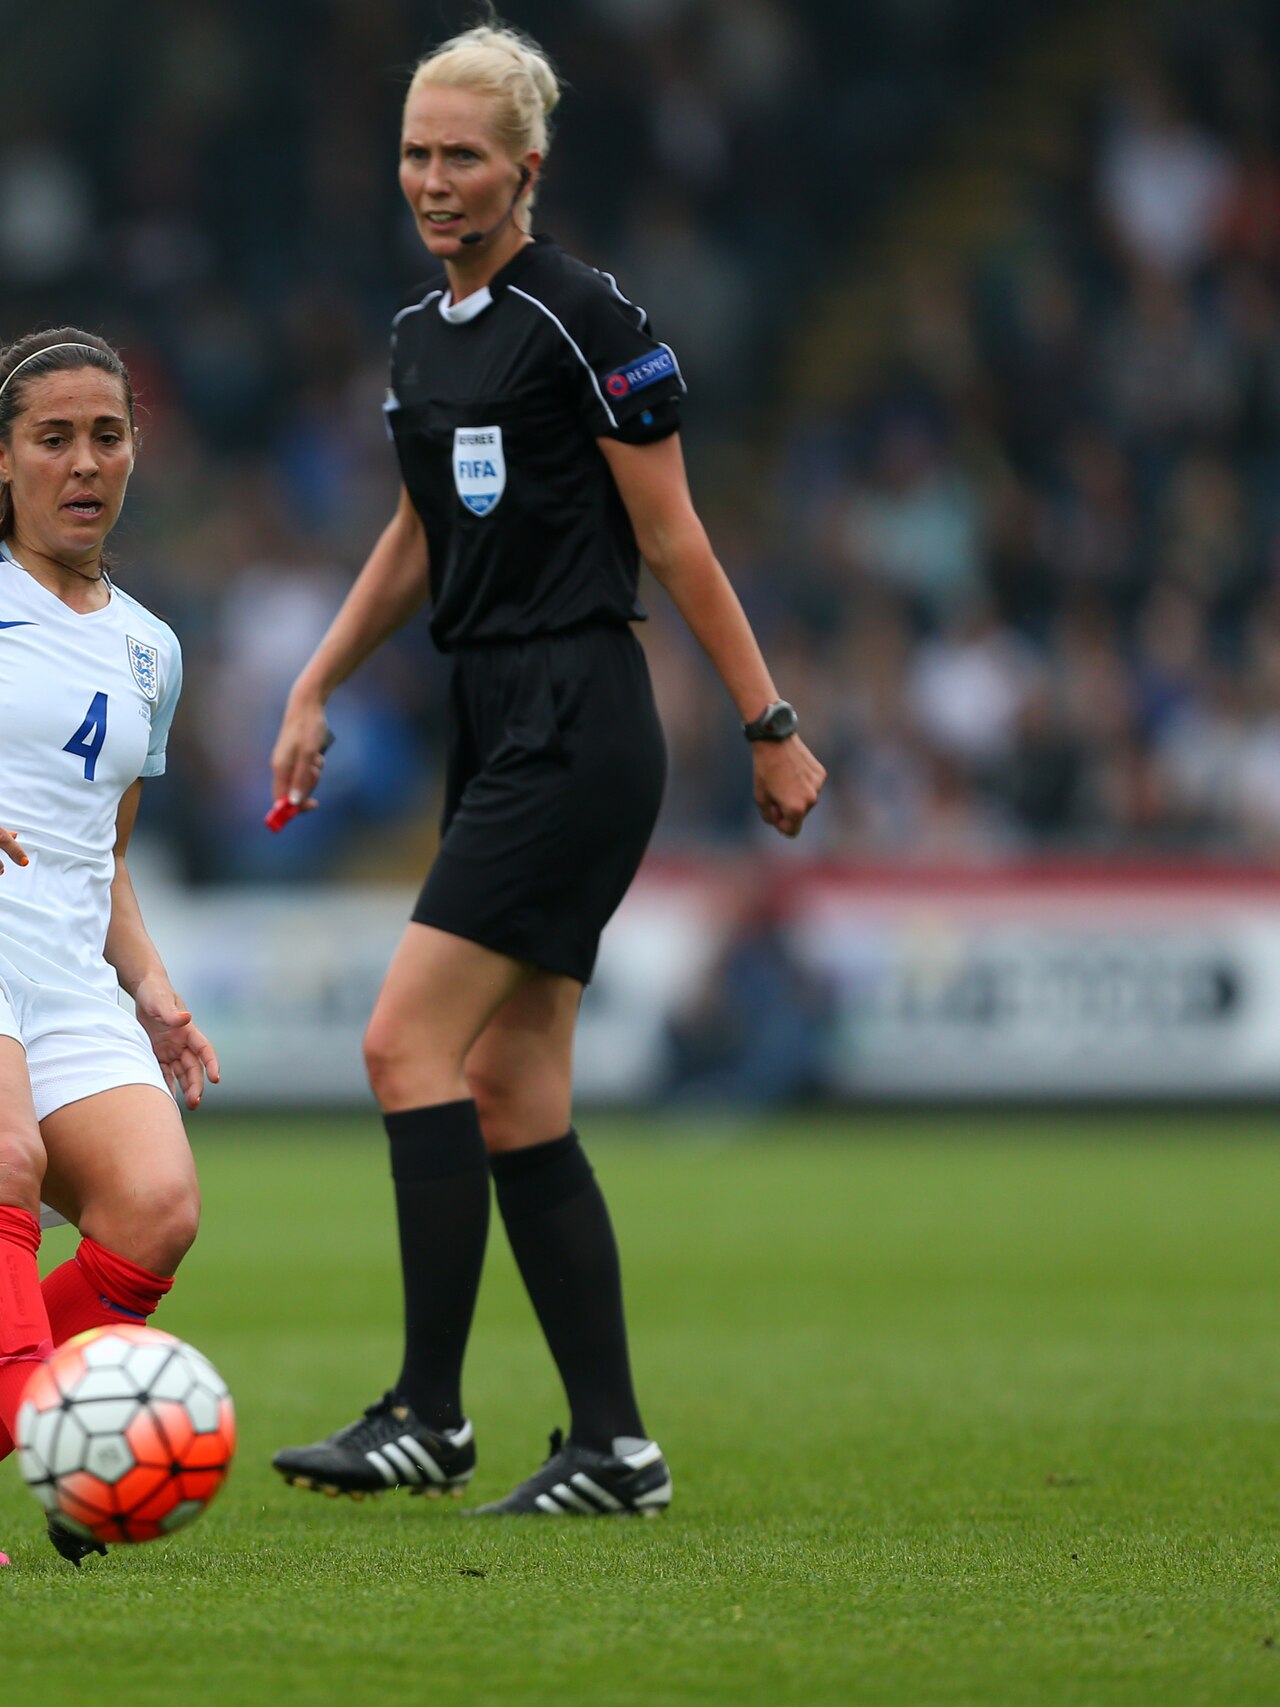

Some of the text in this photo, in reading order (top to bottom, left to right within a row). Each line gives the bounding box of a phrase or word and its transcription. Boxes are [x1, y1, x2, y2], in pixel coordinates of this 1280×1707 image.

[457, 433, 496, 445] EFEREE
[459, 460, 497, 478] FIFA
[62, 691, 108, 782] 4
